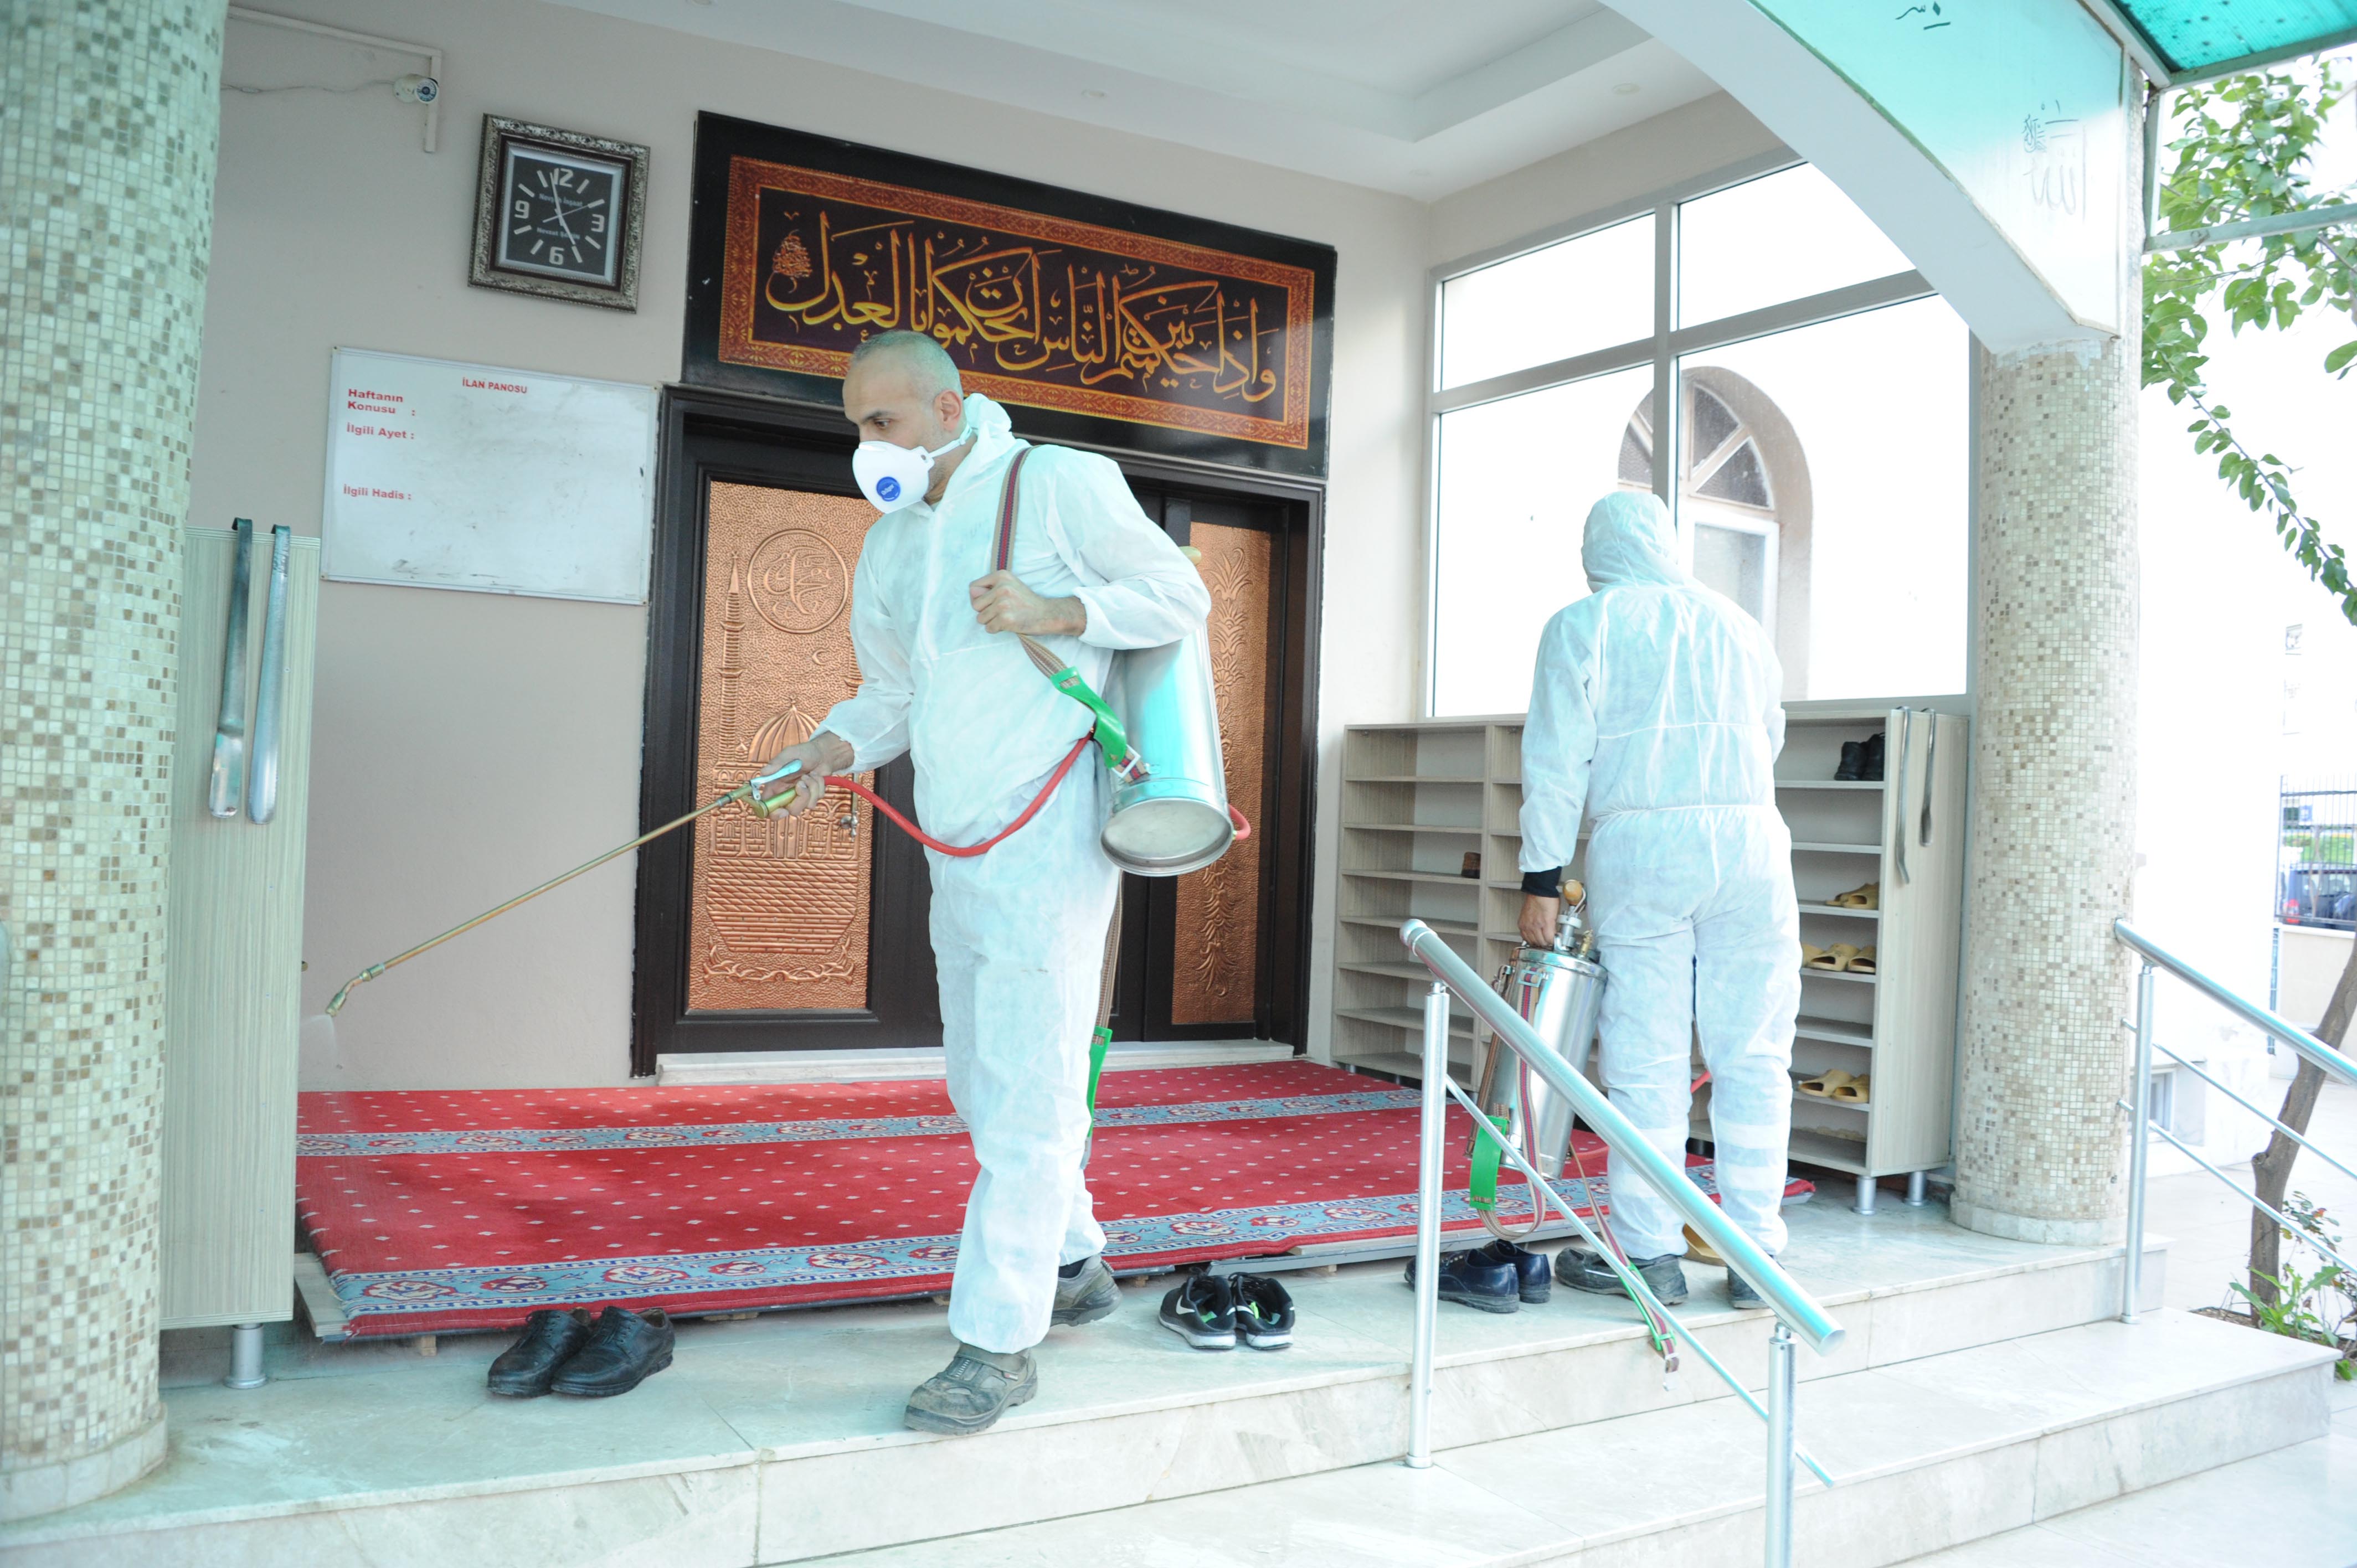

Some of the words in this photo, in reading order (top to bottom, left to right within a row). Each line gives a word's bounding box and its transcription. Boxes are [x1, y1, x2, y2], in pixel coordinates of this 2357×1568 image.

[553, 167, 574, 188] 12
[514, 200, 530, 219] 9
[590, 213, 605, 233] 3
[548, 246, 565, 266] 6
[462, 376, 485, 389] İLAN
[488, 381, 528, 394] PANOSU
[348, 388, 404, 403] Haftanın
[347, 400, 396, 414] Konusu
[346, 422, 374, 436] İlgili
[378, 427, 408, 440] Ayet
[343, 483, 368, 498] İlgili
[372, 488, 404, 500] Hadis
